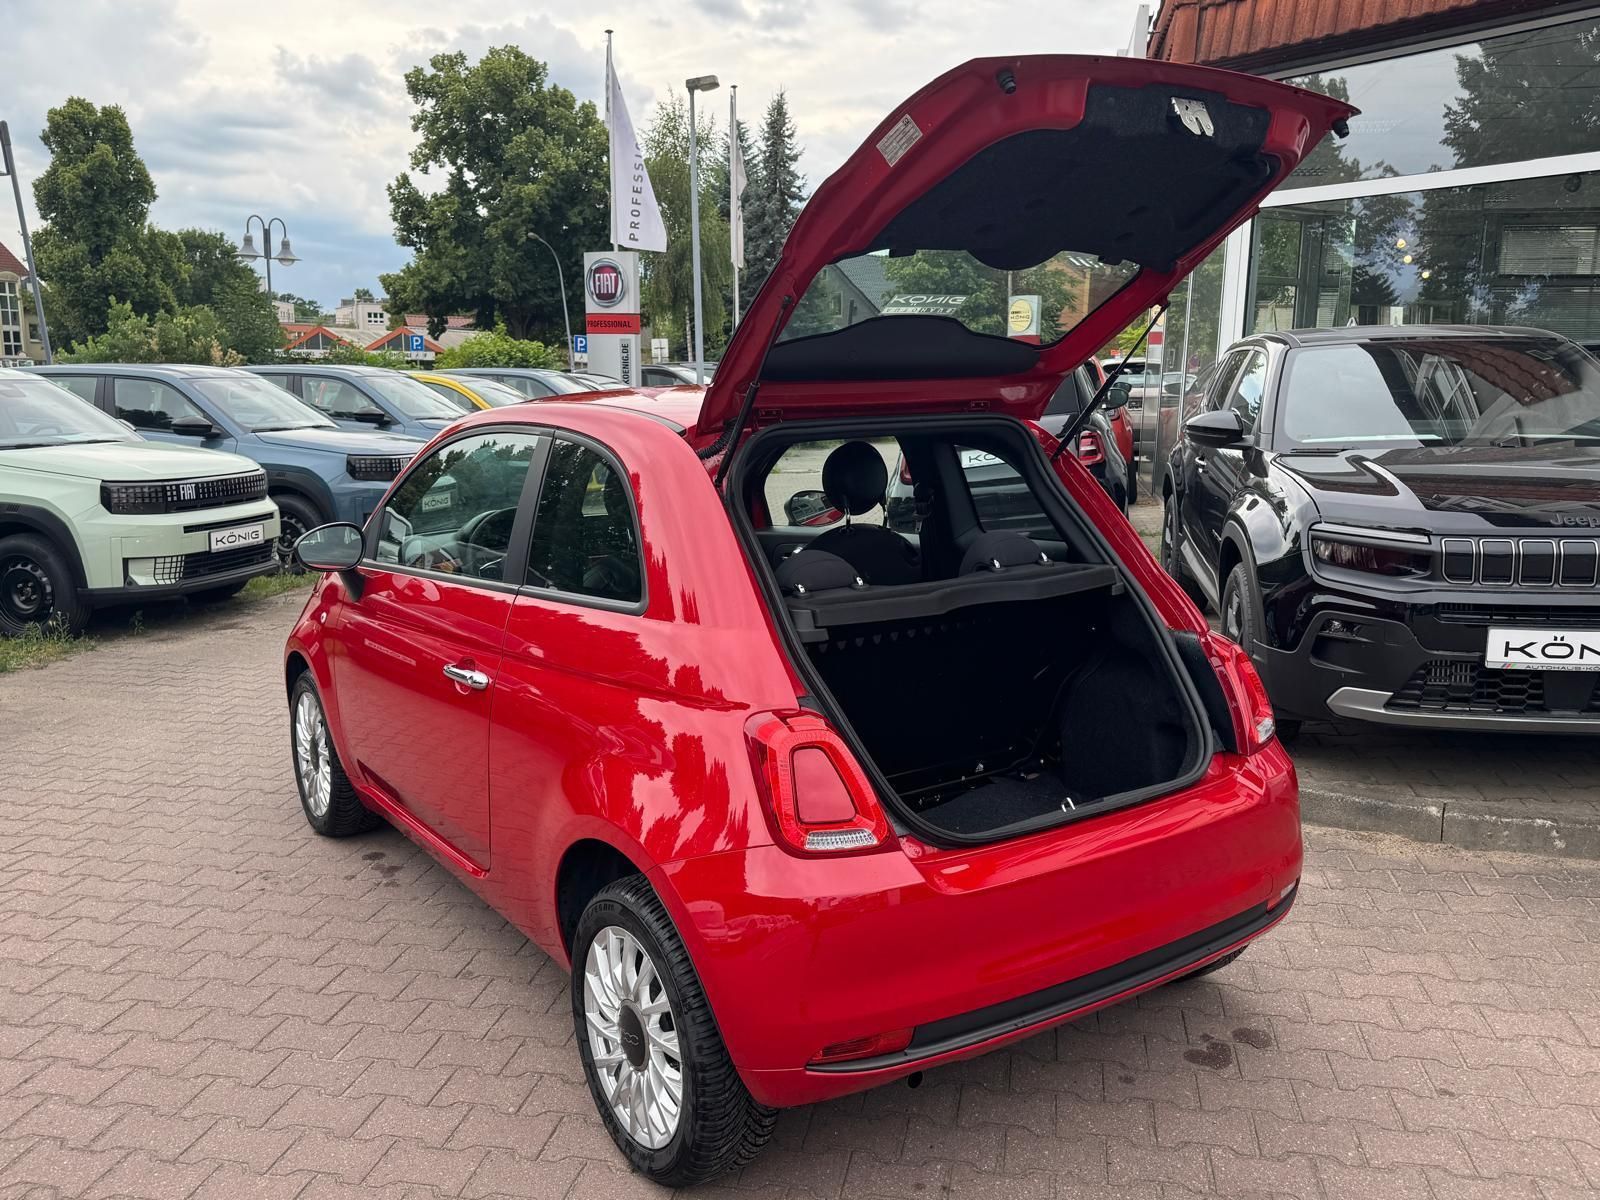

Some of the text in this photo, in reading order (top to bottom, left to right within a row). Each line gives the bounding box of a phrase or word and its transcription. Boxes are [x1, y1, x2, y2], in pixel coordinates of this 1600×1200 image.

[595, 273, 617, 294] FIAT
[587, 320, 633, 328] PROFESSIONAL
[413, 336, 421, 349] P
[577, 337, 586, 352] P
[179, 484, 196, 500] FIAT
[1550, 513, 1600, 528] Jeep
[215, 530, 260, 546] KÖNIG
